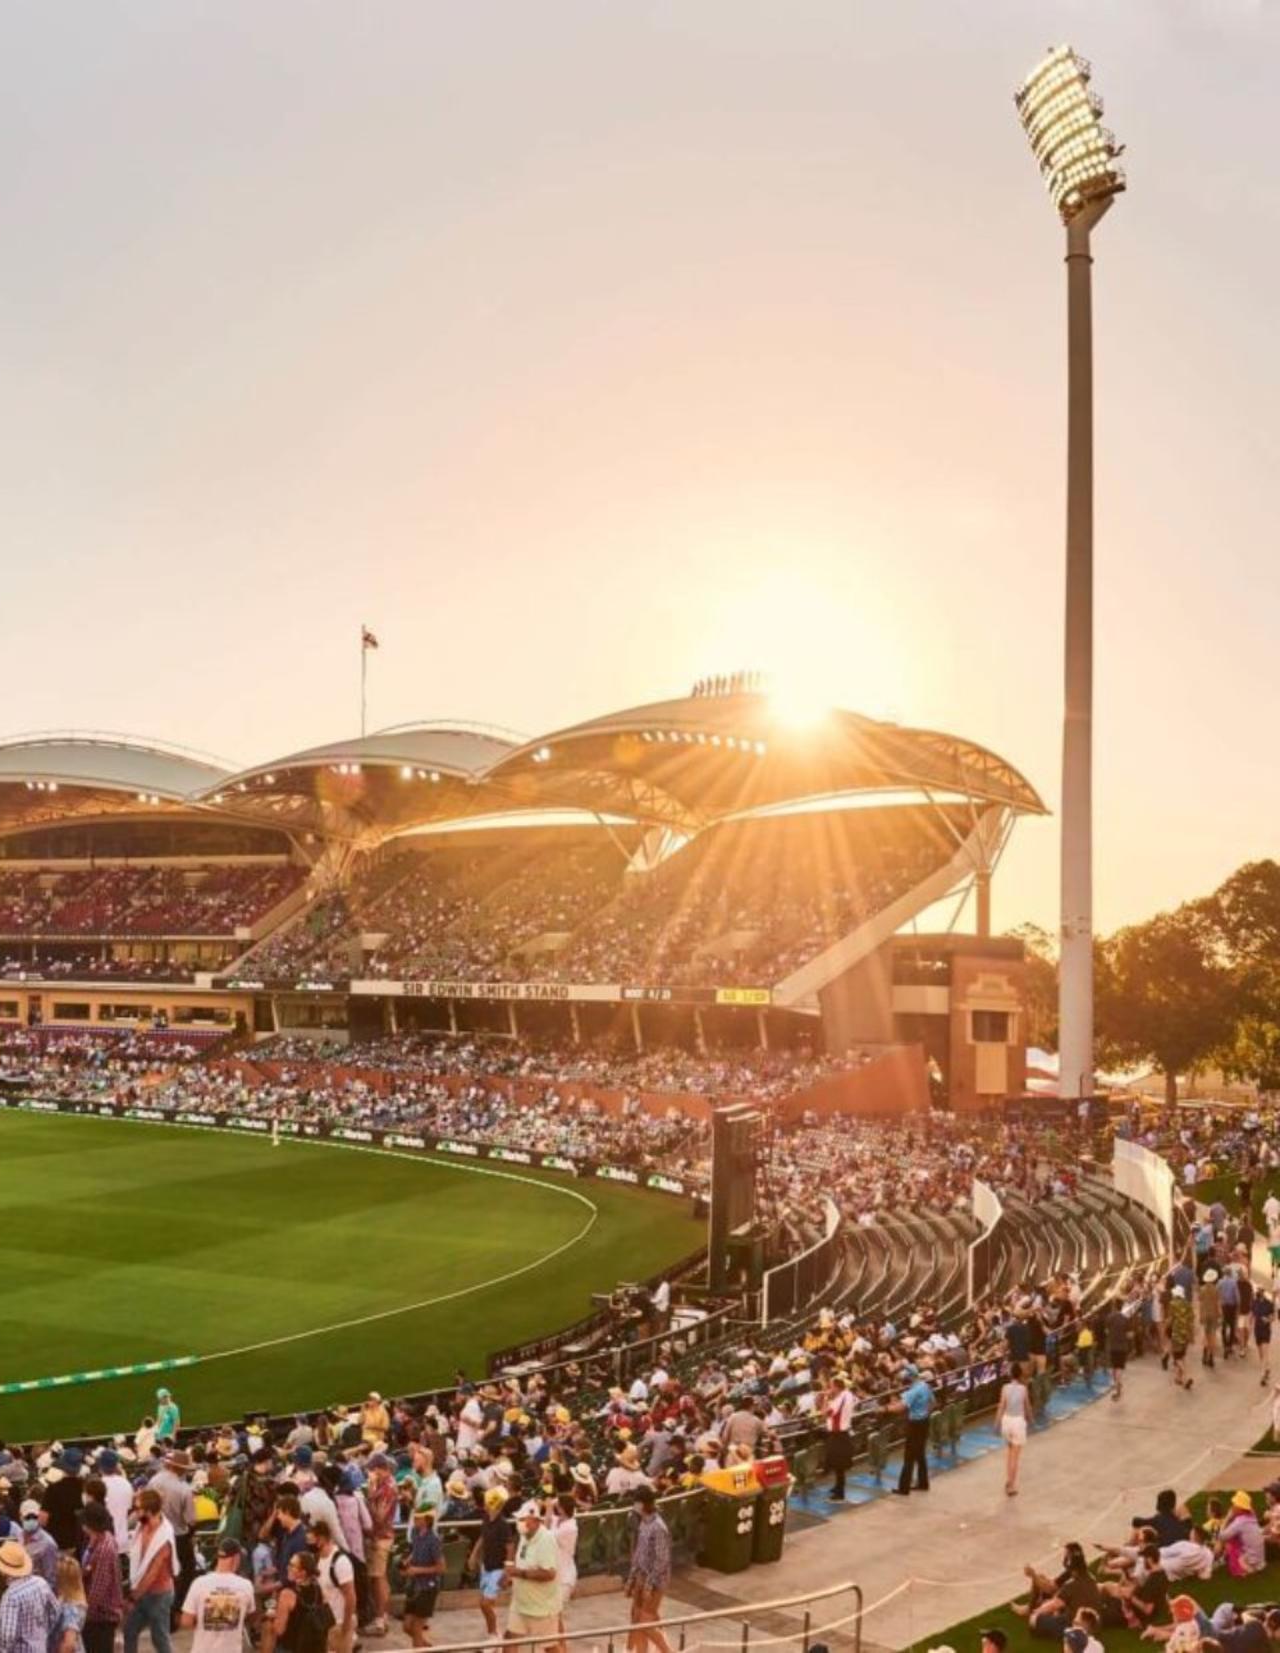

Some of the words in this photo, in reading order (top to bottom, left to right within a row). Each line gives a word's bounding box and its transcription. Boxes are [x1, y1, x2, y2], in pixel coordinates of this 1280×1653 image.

[402, 982, 423, 995] SIR
[429, 983, 472, 997] EDWIN
[478, 984, 518, 998] SMITH
[525, 985, 568, 999] STAND
